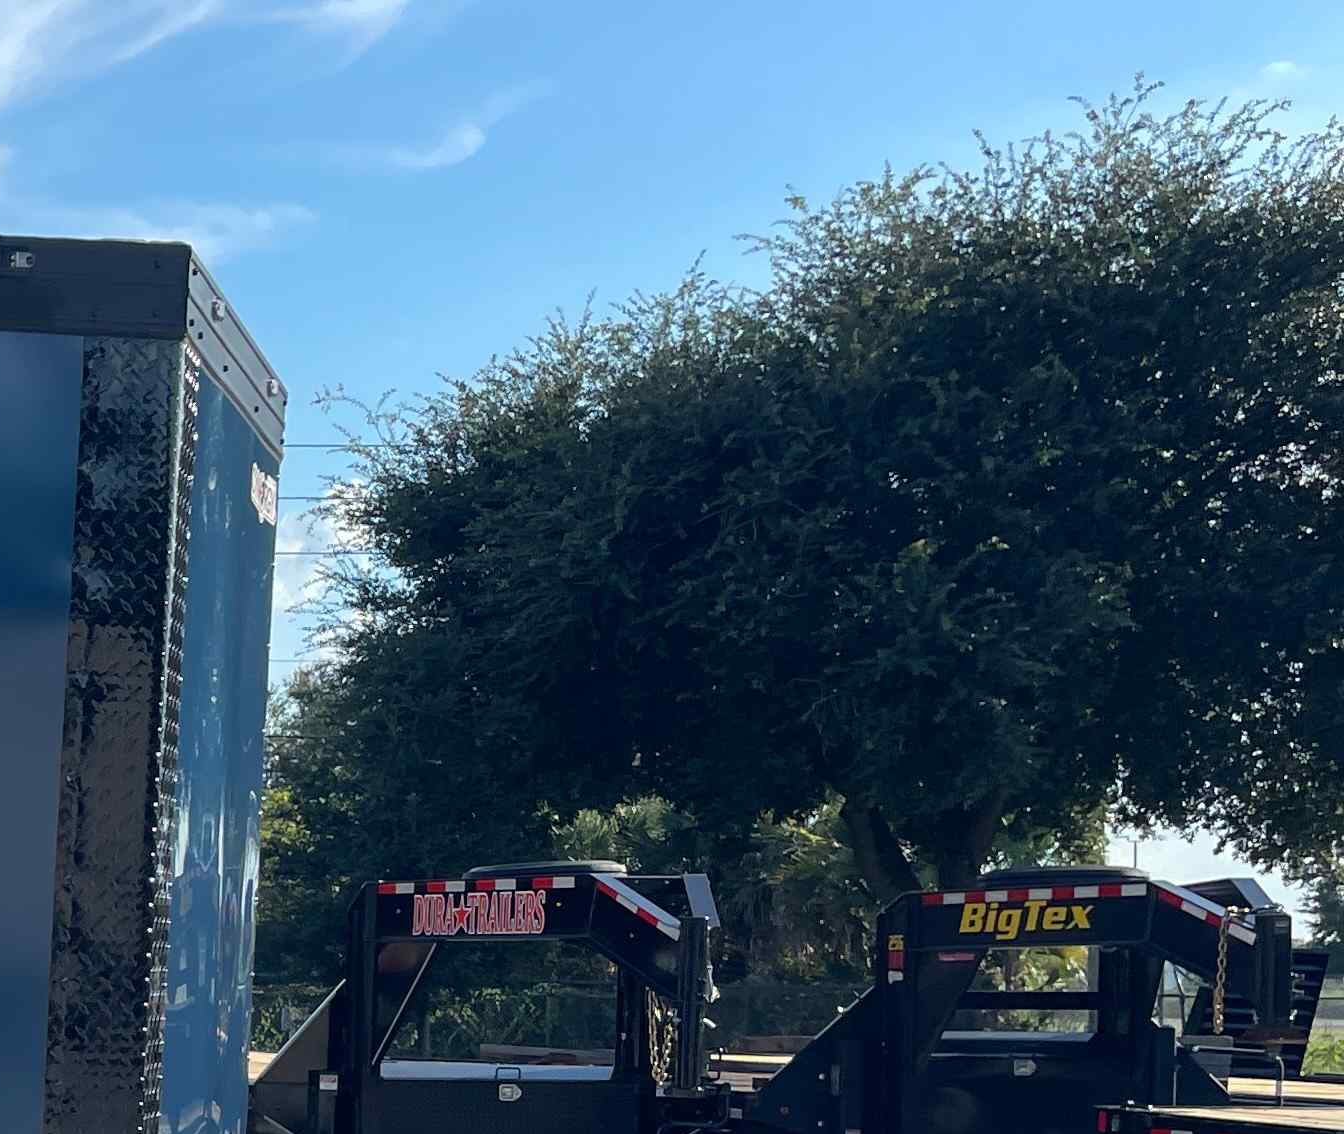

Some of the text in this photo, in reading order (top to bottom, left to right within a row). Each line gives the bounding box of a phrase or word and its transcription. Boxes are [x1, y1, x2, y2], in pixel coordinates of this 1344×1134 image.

[412, 889, 546, 936] DURA TRAILERS
[959, 900, 1095, 941] BigTex
